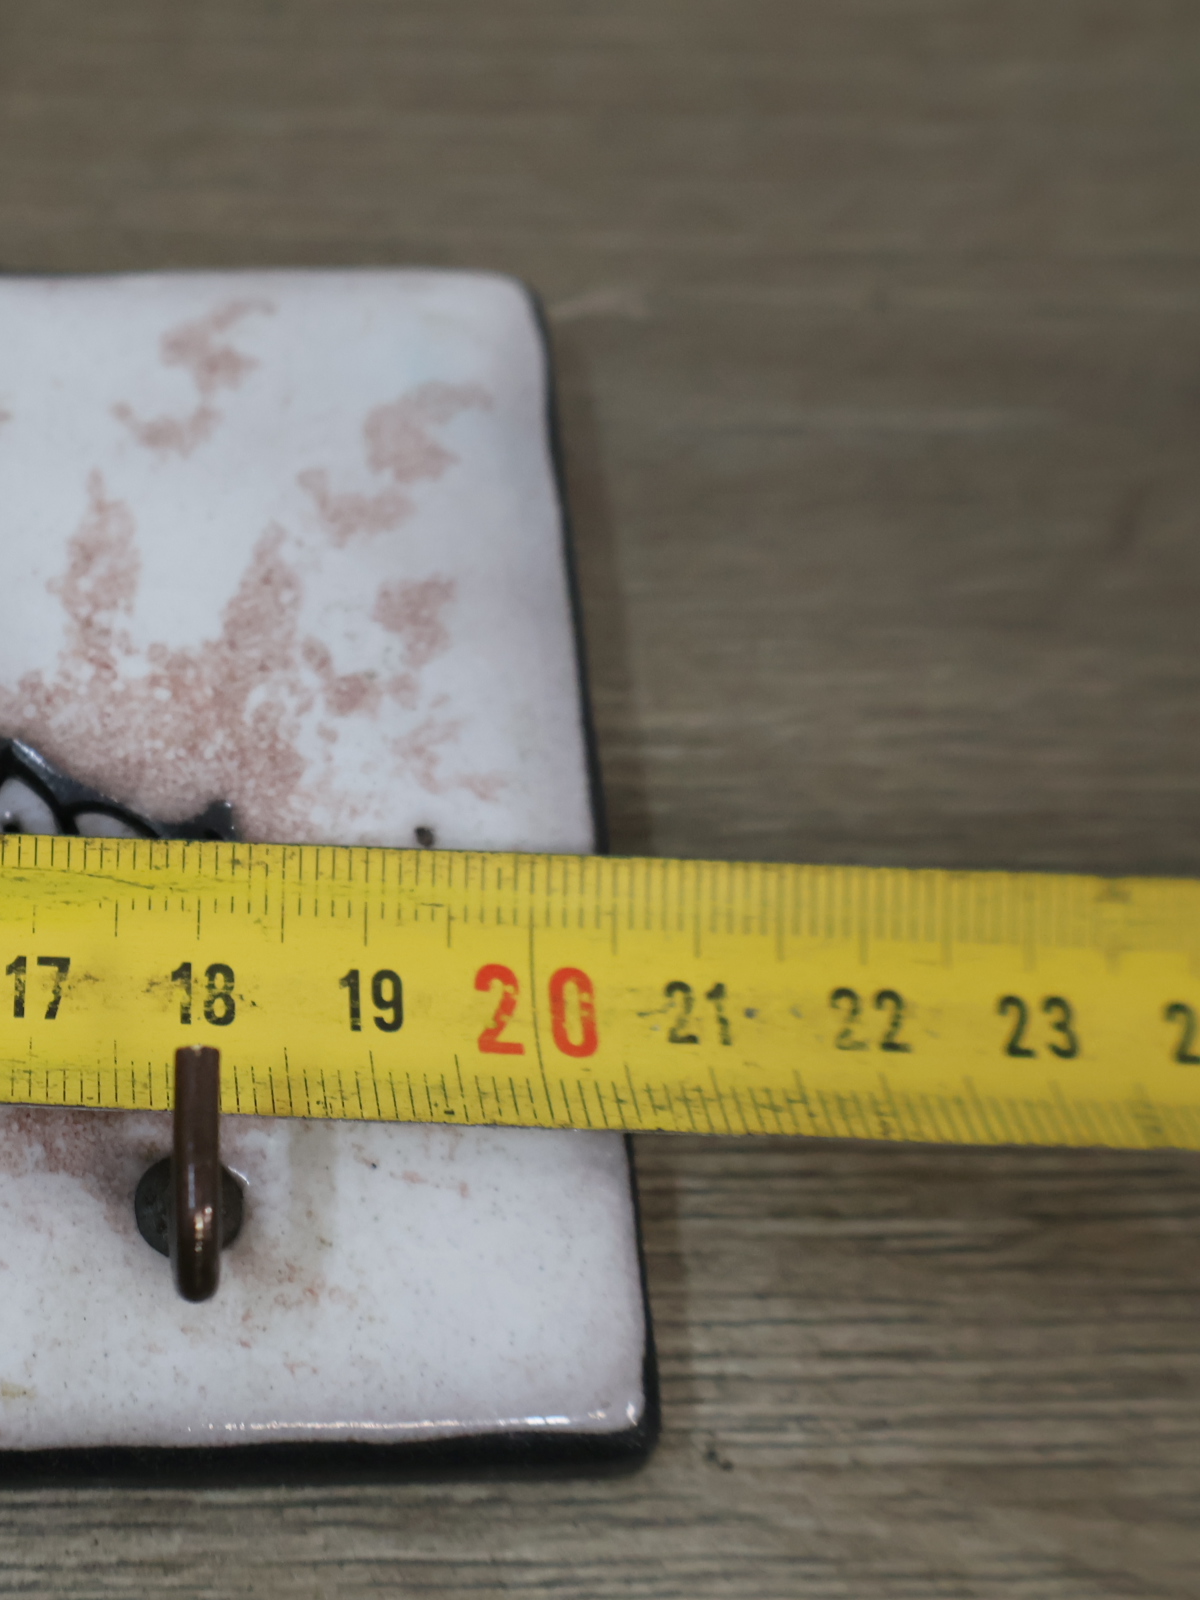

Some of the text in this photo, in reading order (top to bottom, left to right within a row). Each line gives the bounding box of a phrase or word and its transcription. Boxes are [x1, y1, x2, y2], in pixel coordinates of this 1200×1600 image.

[5, 955, 71, 1020] 17
[171, 961, 236, 1027] 18
[338, 968, 404, 1033] 19
[474, 963, 599, 1058] 20
[664, 981, 733, 1046] 21
[830, 987, 911, 1053] 22
[997, 995, 1080, 1059] 23
[1164, 1002, 1200, 1066] 2
